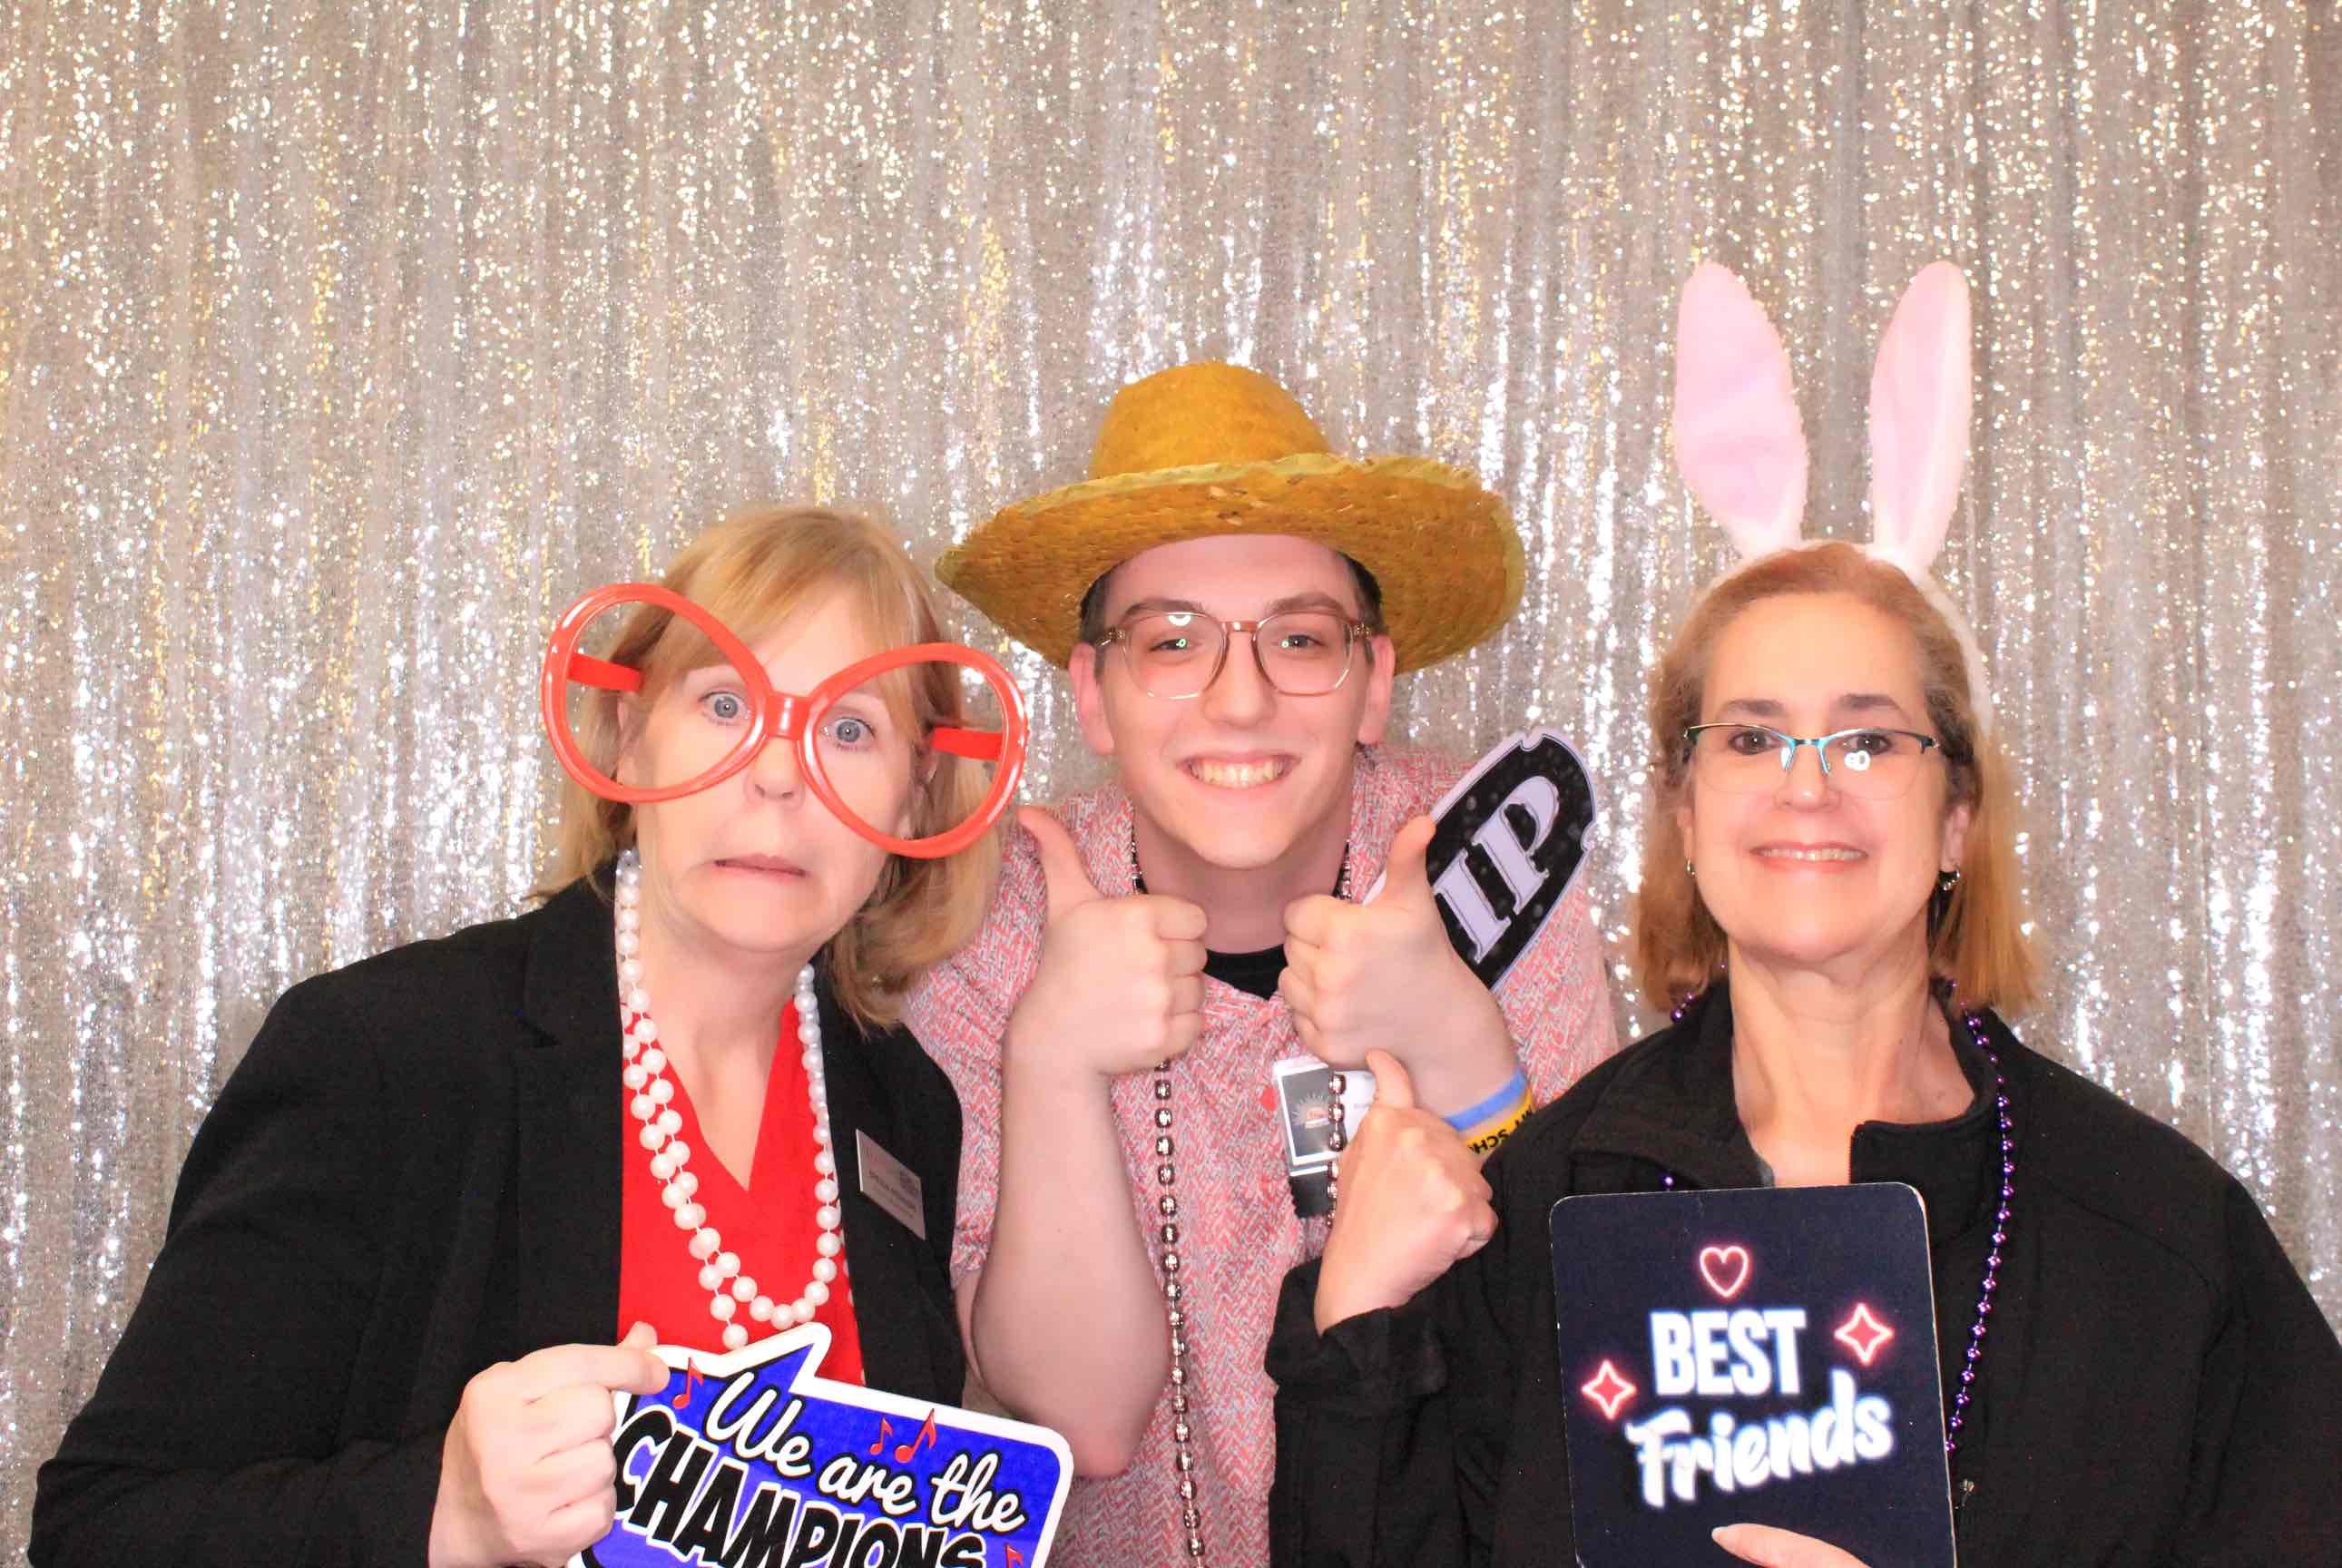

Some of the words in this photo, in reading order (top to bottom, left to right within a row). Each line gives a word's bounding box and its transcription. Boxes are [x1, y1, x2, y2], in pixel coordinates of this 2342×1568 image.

[1433, 775, 1560, 964] IP
[1469, 1128, 1511, 1154] SCH
[1649, 1308, 1808, 1396] BEST
[706, 1371, 812, 1476] We
[819, 1453, 916, 1515] are
[930, 1453, 1026, 1532] the
[1625, 1367, 1895, 1510] Friends
